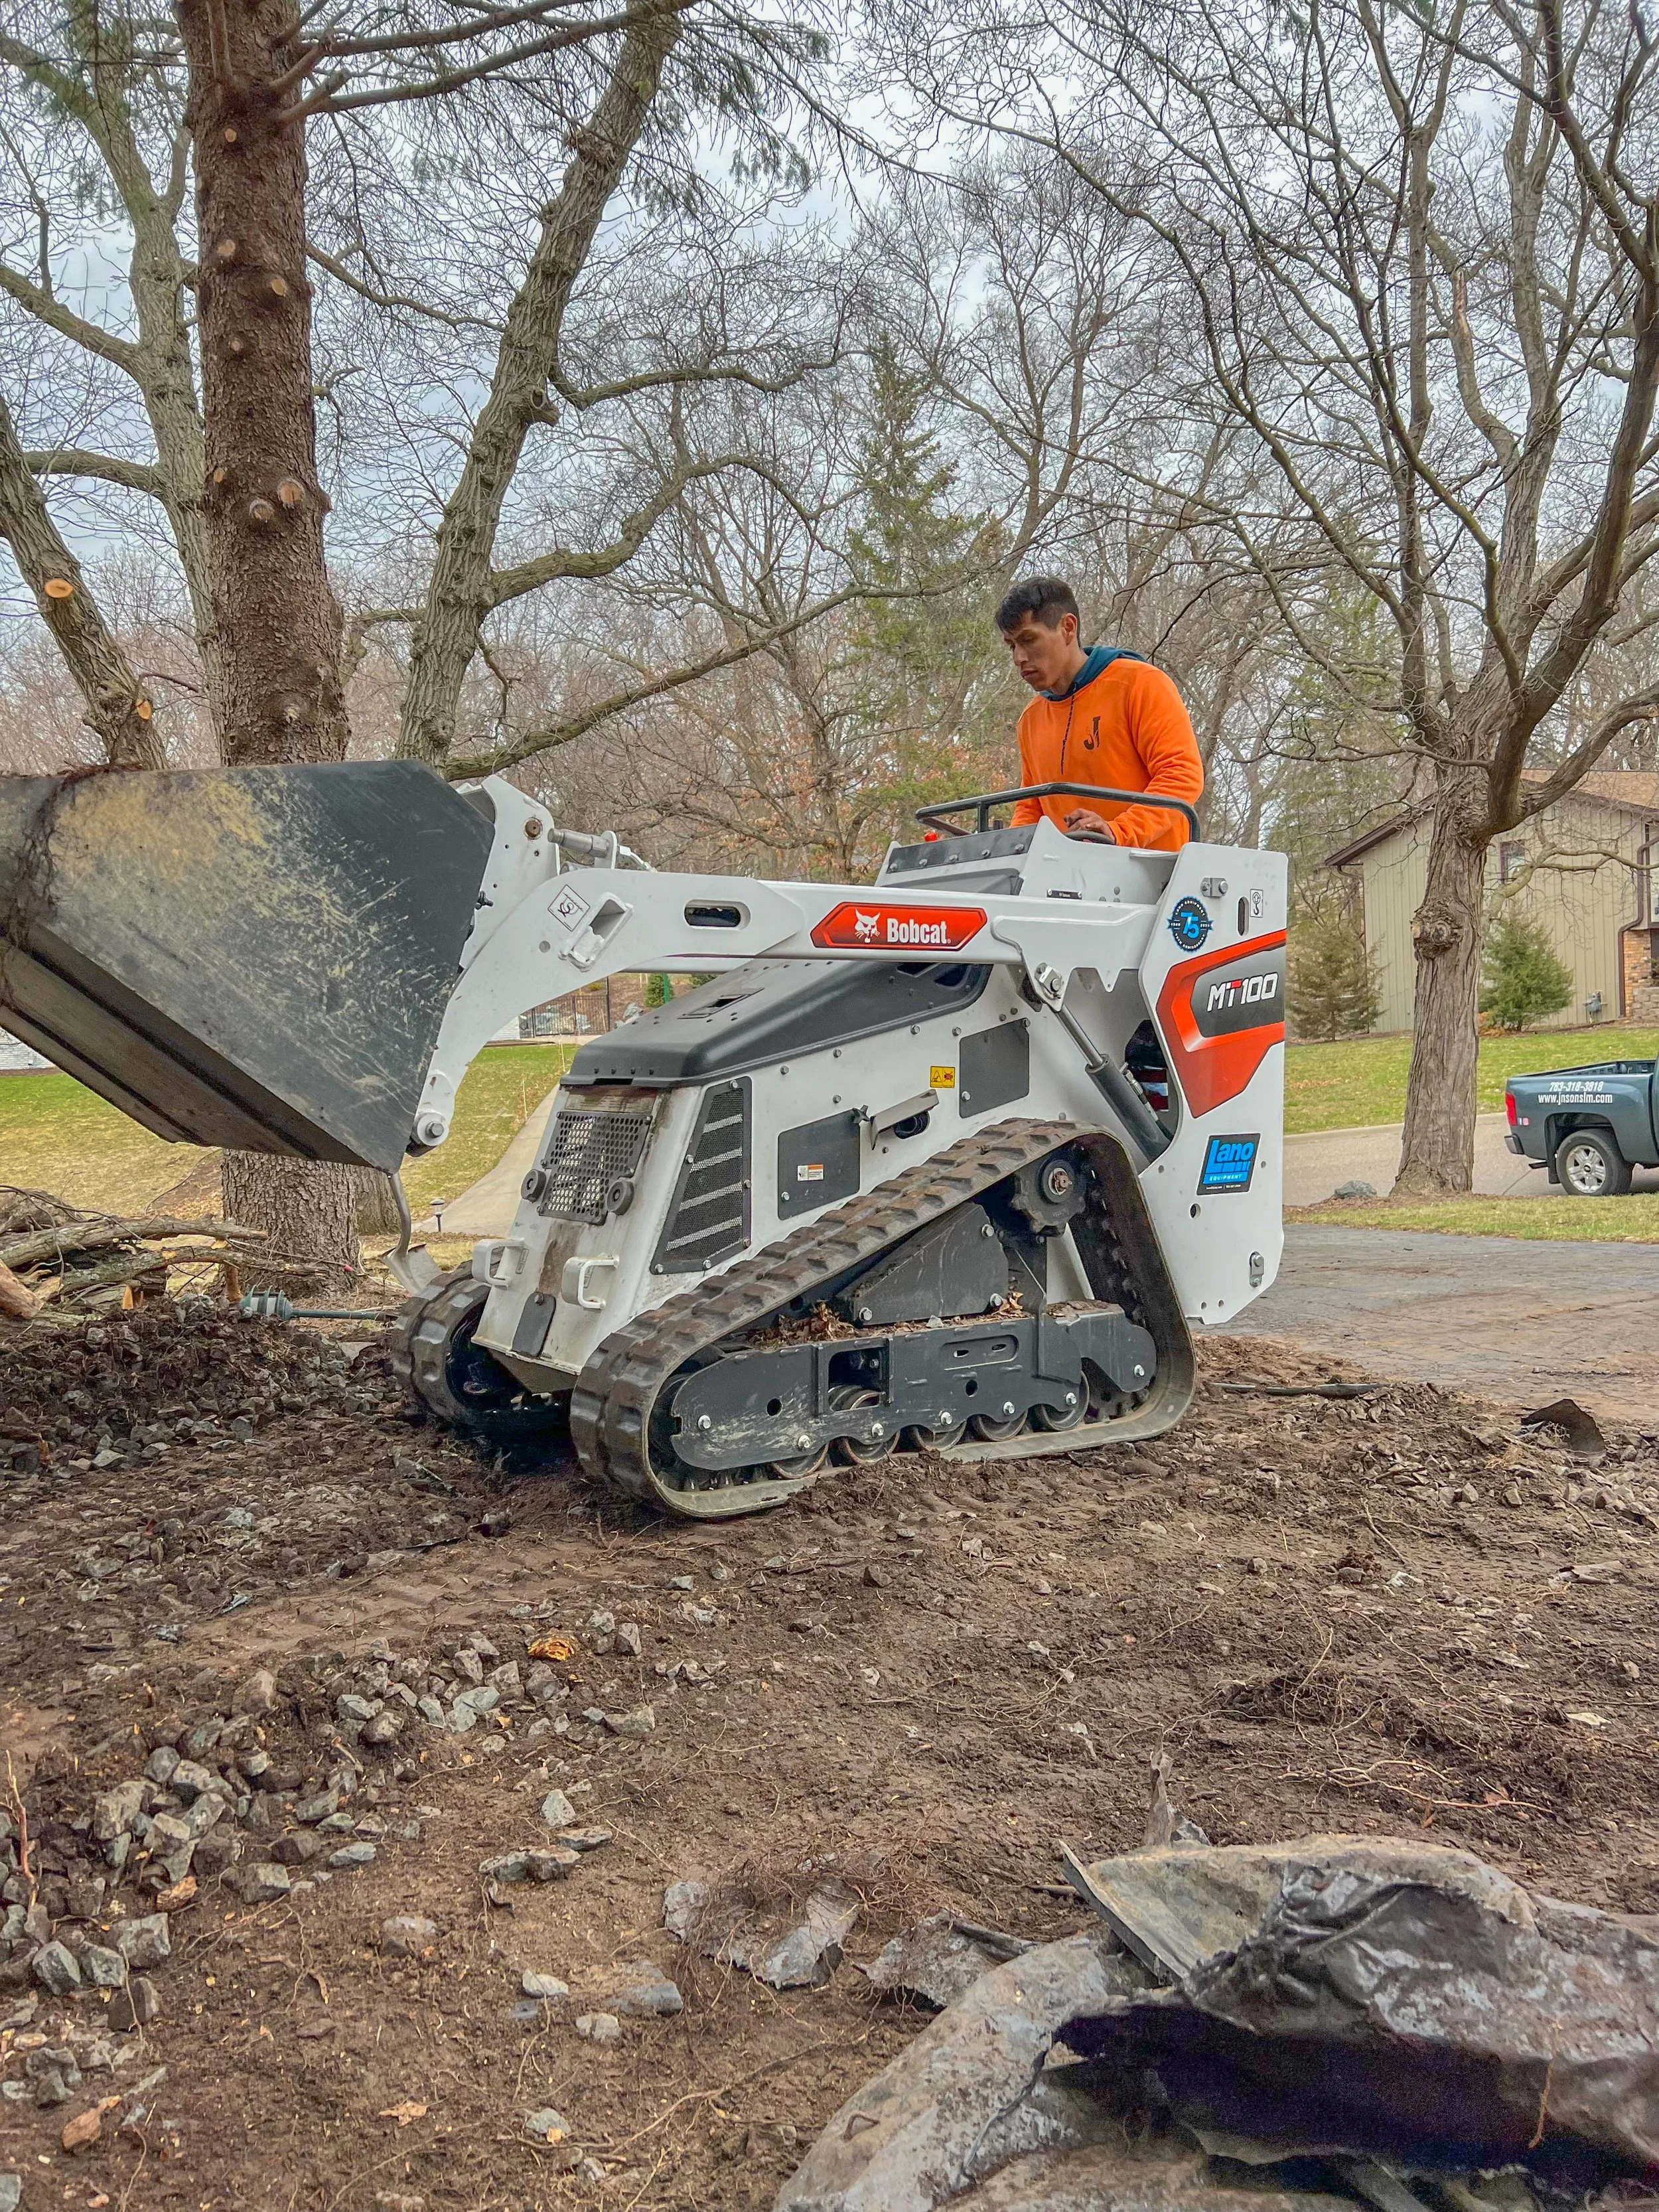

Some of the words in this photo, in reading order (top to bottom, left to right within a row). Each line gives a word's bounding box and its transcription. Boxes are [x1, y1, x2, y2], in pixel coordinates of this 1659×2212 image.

[887, 918, 948, 944] Bobcat
[1181, 912, 1199, 938] 75
[1206, 972, 1278, 1012] MT100
[1538, 1092, 1613, 1106] www.jnsonslm.com
[1205, 1140, 1255, 1174] Lano
[1209, 1173, 1243, 1182] EQUIPMENT
